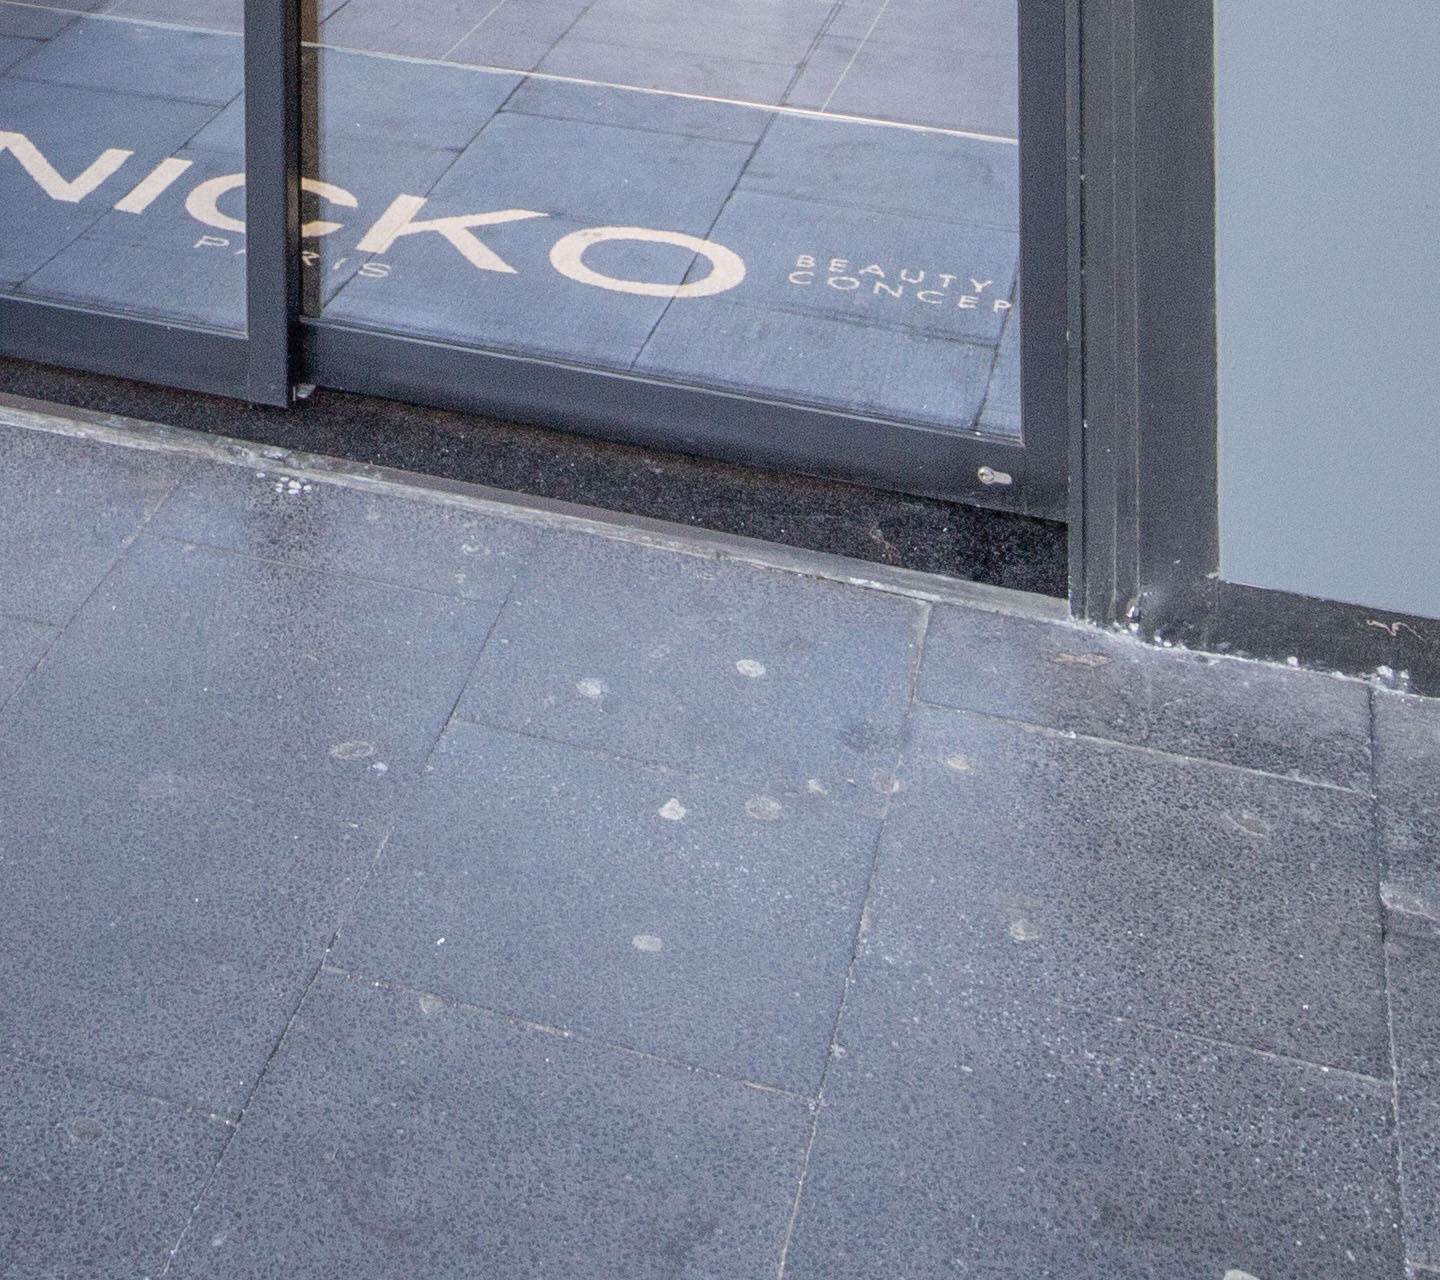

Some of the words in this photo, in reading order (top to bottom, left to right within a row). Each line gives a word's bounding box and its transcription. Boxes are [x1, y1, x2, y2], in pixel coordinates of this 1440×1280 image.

[193, 235, 391, 278] PRIS
[796, 255, 993, 293] BEAUTY
[788, 271, 1012, 313] CONCEP
